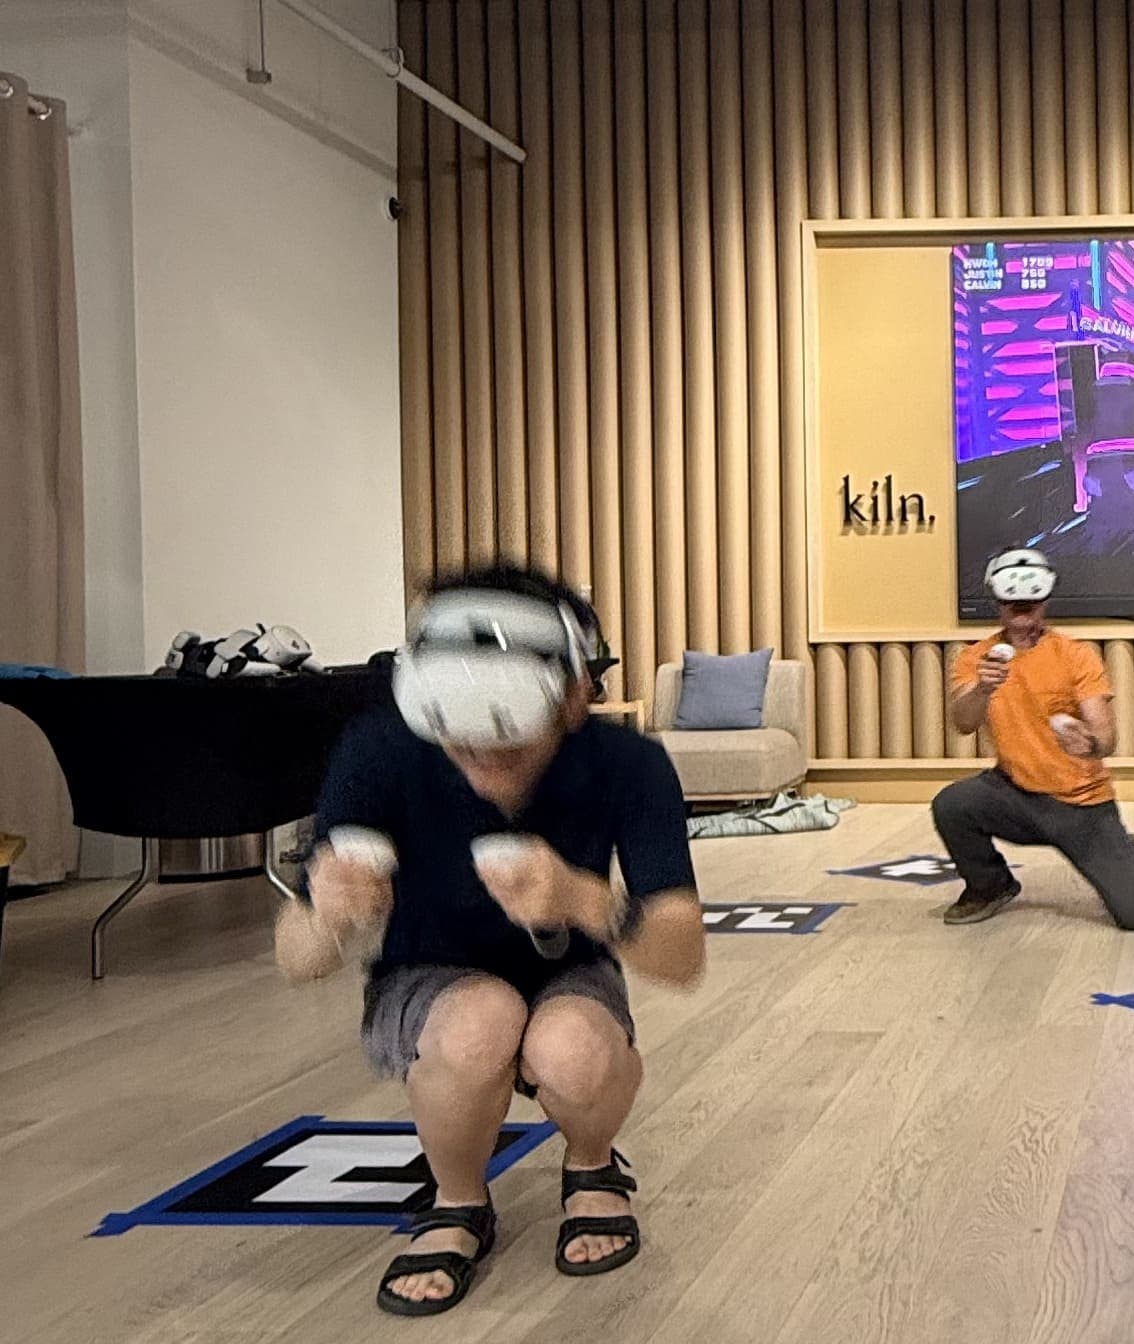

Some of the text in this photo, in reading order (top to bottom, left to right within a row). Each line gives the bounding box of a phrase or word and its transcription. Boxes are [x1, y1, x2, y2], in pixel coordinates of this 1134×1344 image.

[963, 268, 1003, 279] JUSTIN
[964, 280, 1002, 290] CALVIN
[841, 474, 936, 523] kiln.
